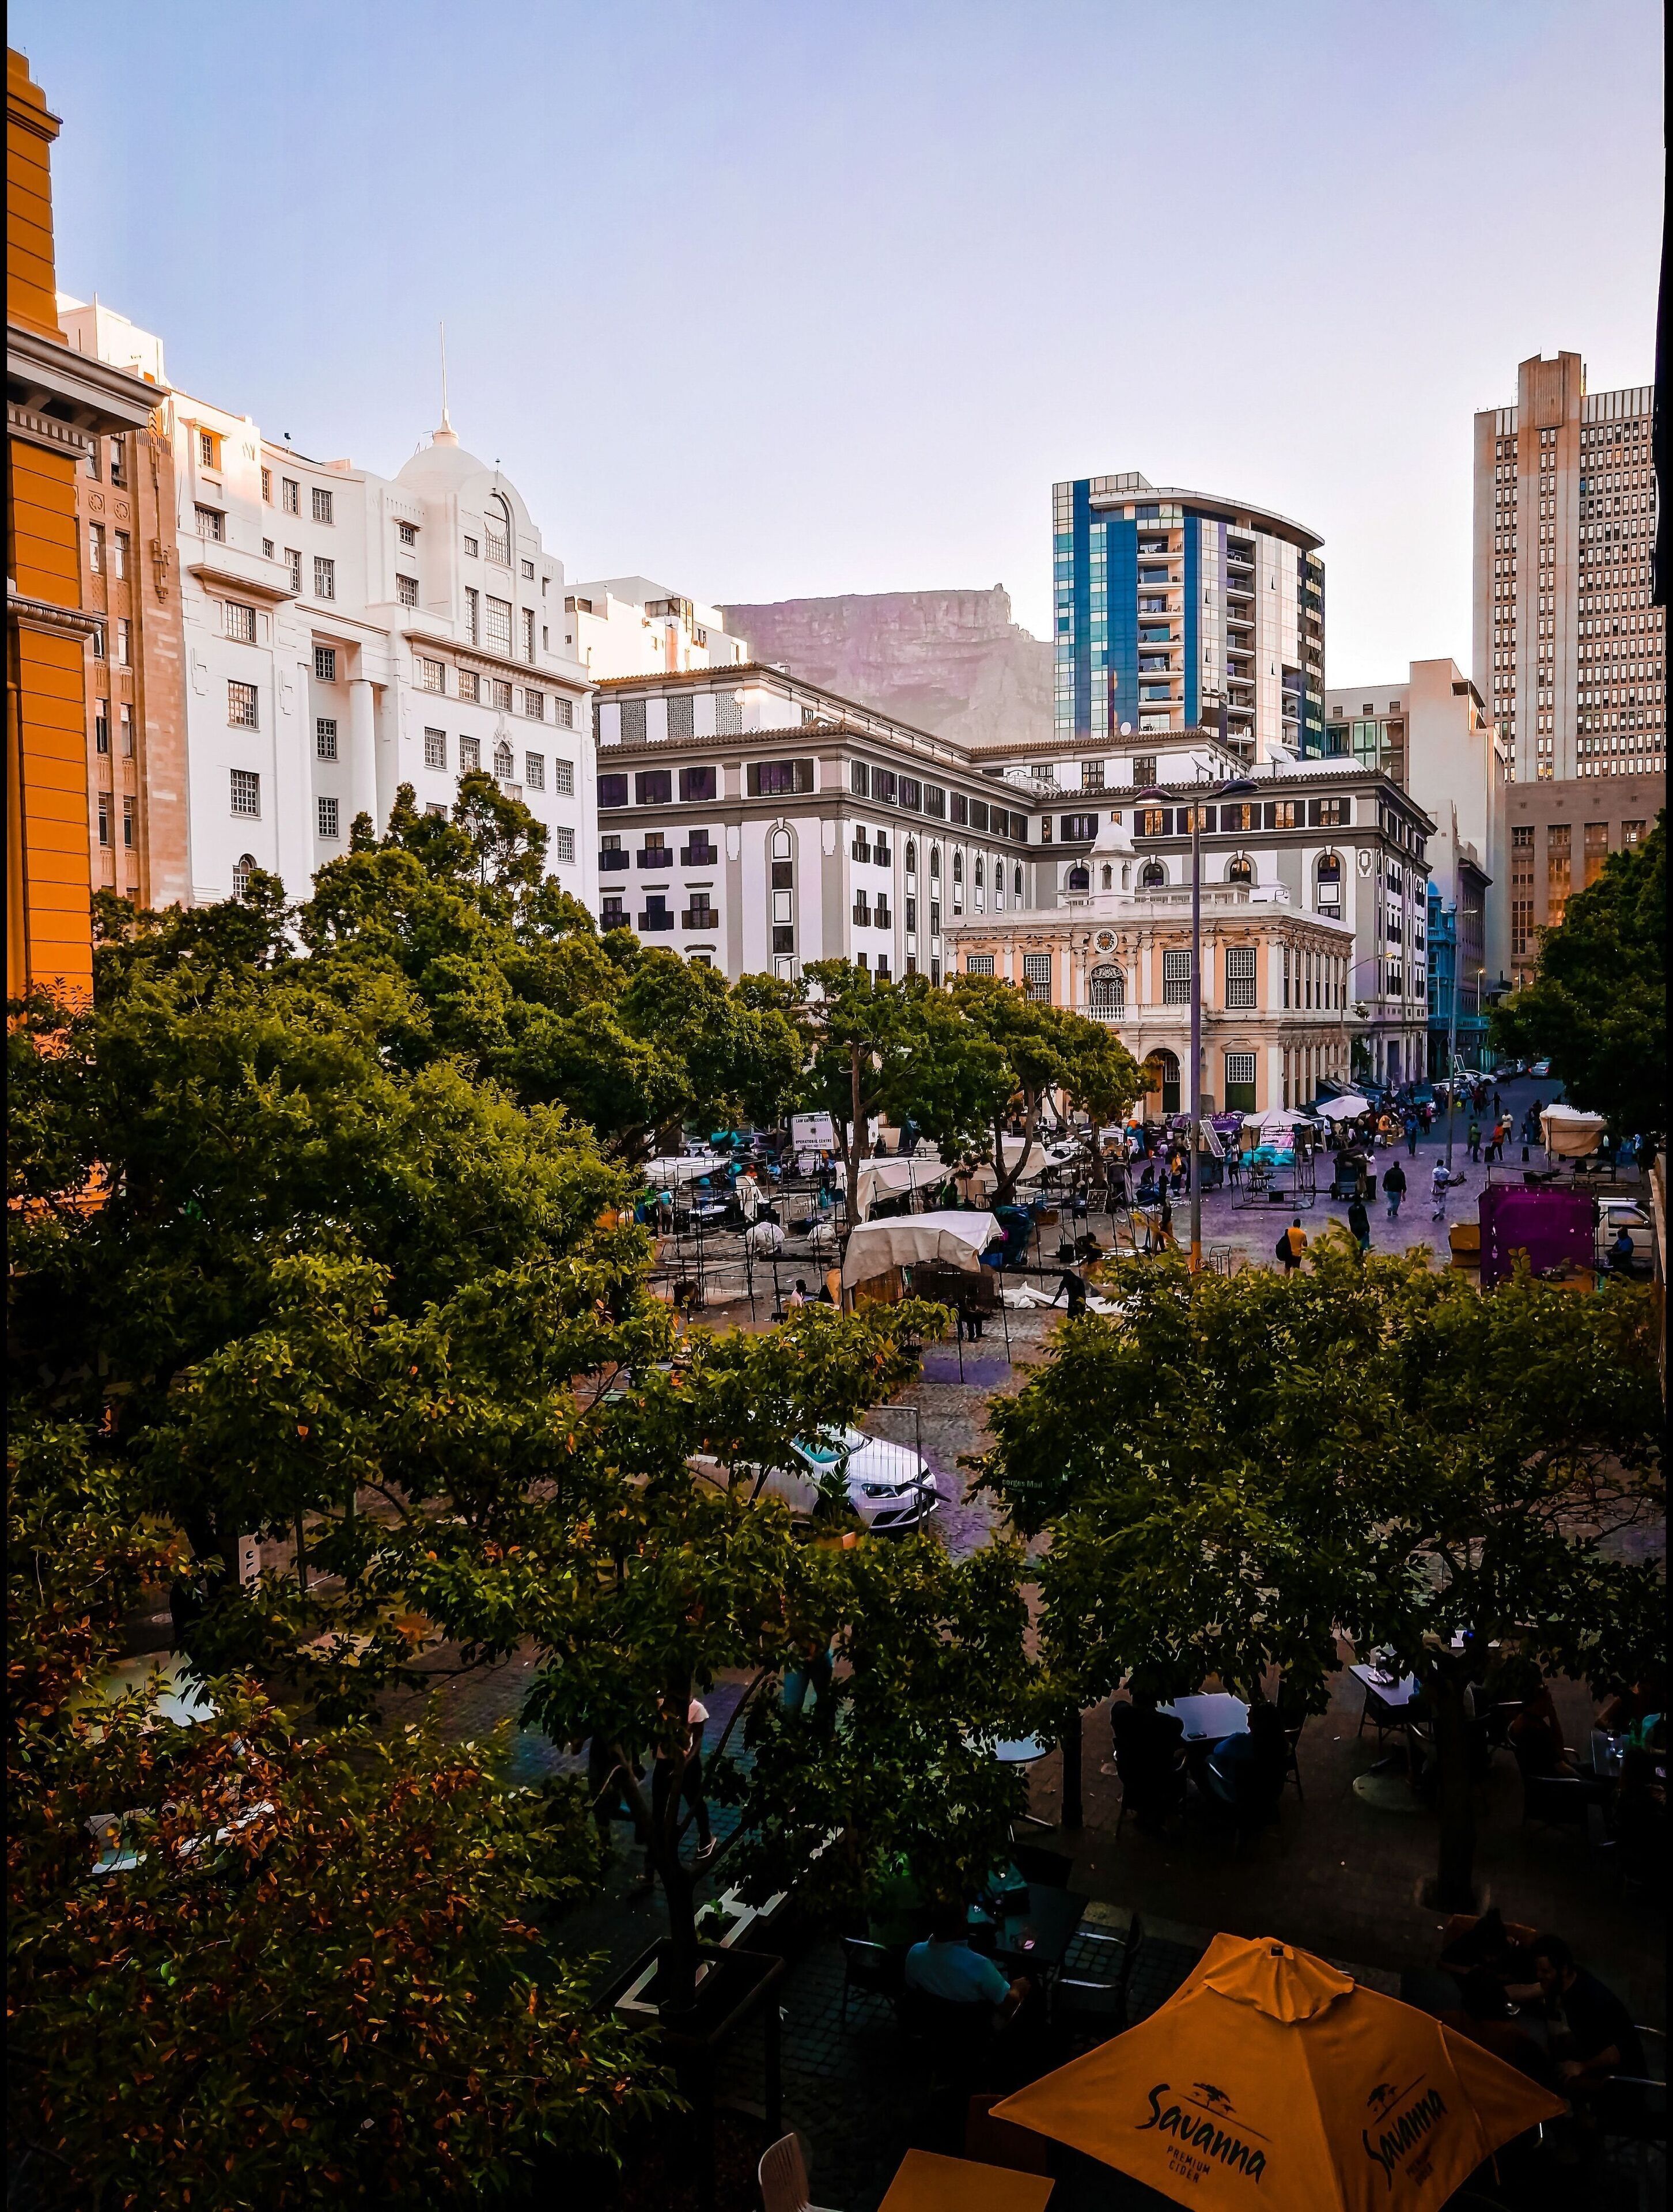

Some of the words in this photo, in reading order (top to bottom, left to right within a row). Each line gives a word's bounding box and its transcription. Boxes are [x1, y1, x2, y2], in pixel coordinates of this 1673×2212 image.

[1134, 2083, 1267, 2184] Savanna
[1167, 2145, 1211, 2175] PREMIUM
[1362, 2088, 1448, 2192] Savanna
[1169, 2160, 1200, 2184] CIDER
